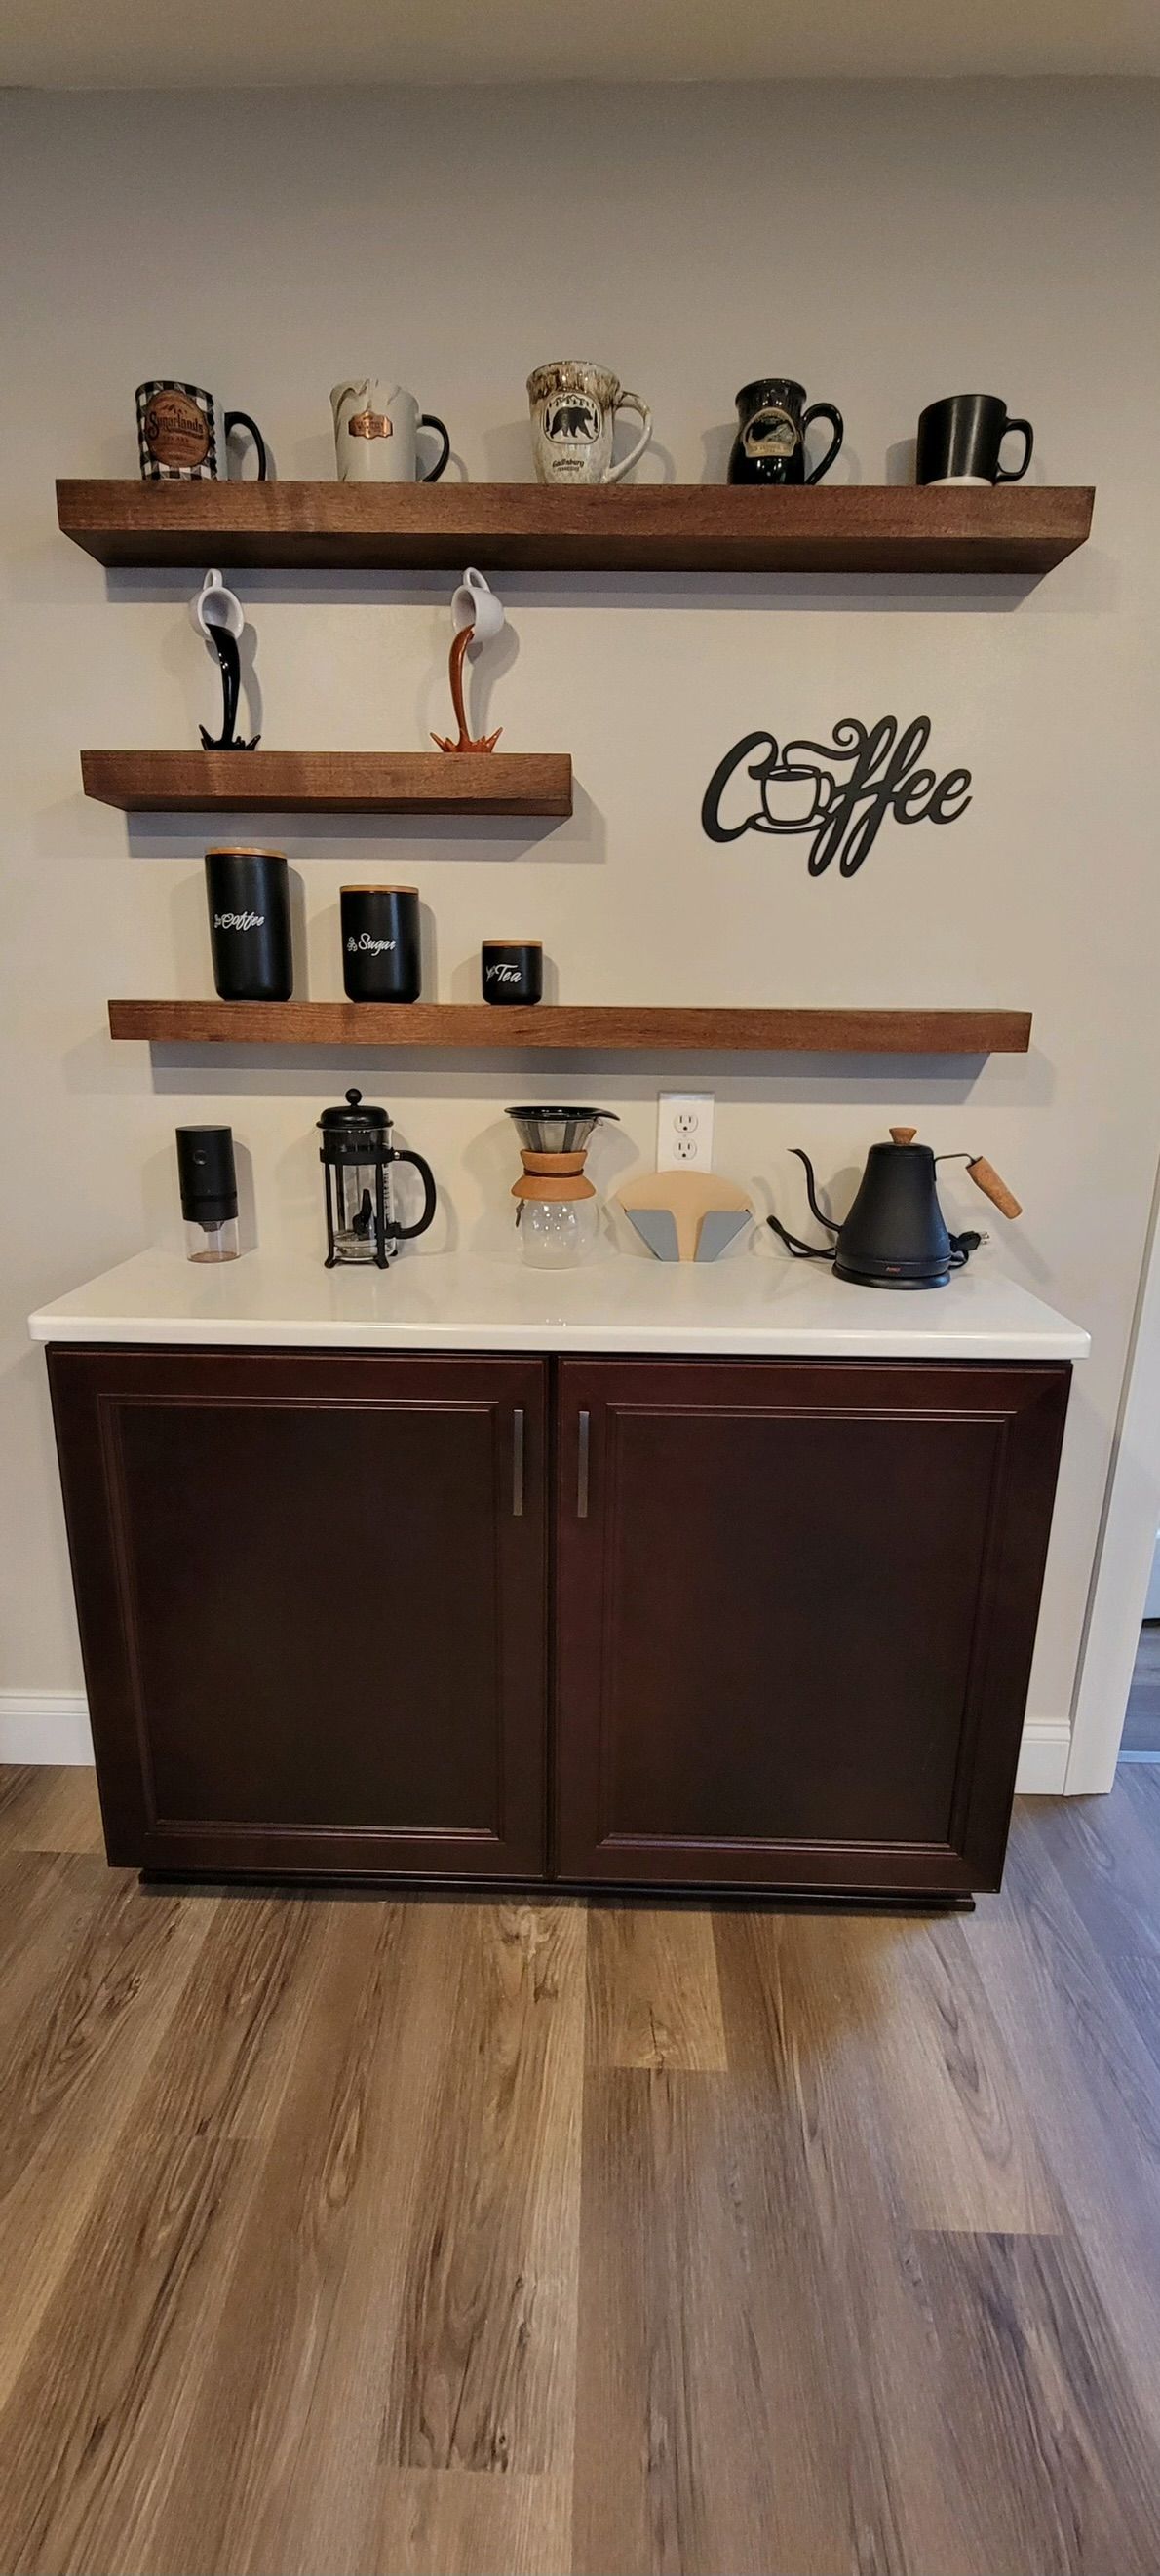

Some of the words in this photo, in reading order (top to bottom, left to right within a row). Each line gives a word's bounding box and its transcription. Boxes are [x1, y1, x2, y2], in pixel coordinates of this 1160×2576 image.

[701, 715, 973, 878] Coffee
[221, 911, 264, 931] Coffee
[358, 932, 396, 956] Sugar
[495, 964, 522, 982] Tea
